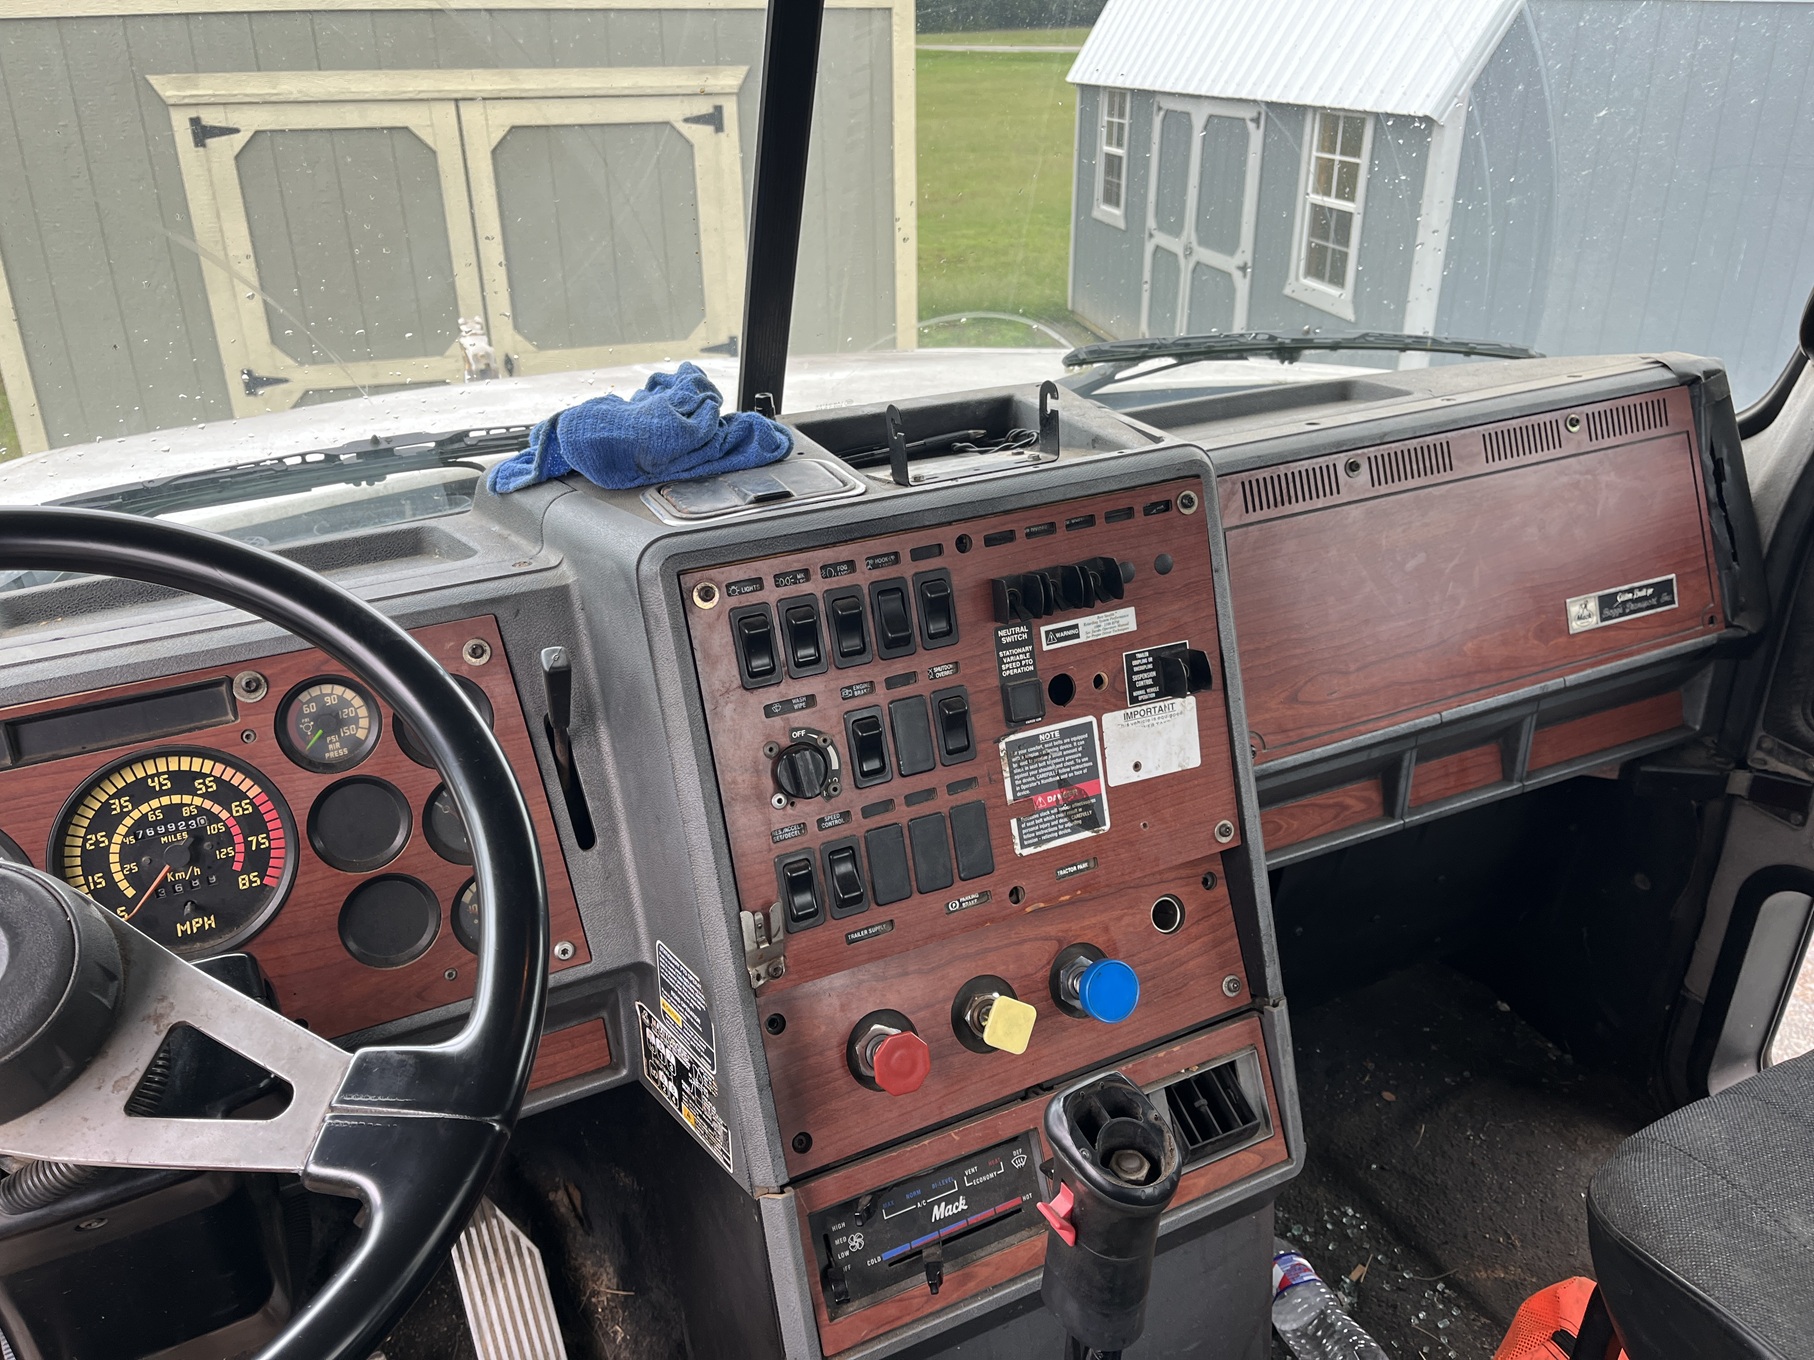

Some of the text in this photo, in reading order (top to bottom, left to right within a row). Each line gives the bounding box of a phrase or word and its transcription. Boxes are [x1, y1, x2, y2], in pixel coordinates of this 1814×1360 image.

[741, 584, 760, 592] LIGHTS
[998, 626, 1028, 636] NEUTRAL
[1056, 629, 1079, 638] WARNING
[1002, 633, 1028, 644] SWITCH
[999, 646, 1032, 657] STATIONARY
[1003, 653, 1030, 663] VARIABLE
[1002, 659, 1033, 670] SPEED PTO
[1002, 666, 1034, 676] OPERATION
[324, 695, 338, 705] 90
[303, 703, 316, 713] 60
[794, 702, 807, 710] WIPE
[1124, 702, 1175, 720] IMPORTANT
[339, 708, 355, 719] 120
[340, 725, 356, 737] 150
[792, 730, 806, 738] OFF
[1039, 731, 1060, 741] NOTE
[327, 735, 338, 743] PSI
[329, 742, 340, 751] AIR
[325, 748, 348, 759] PRESS
[148, 775, 172, 792] 45
[194, 777, 217, 794] 55
[109, 797, 132, 814] 35
[182, 805, 198, 817] 85
[231, 800, 253, 817] 65
[148, 810, 163, 822] 65
[207, 823, 225, 834] 105
[821, 819, 844, 828] CONTROL
[86, 832, 109, 850] 25
[123, 835, 136, 844] 45
[161, 832, 188, 844] MILES
[248, 834, 269, 850] 75
[216, 847, 235, 859] 125
[123, 862, 138, 874] 25
[1077, 862, 1088, 870] PARK
[167, 866, 201, 883] Km/h
[88, 873, 106, 890] 15
[238, 872, 261, 890] 85
[177, 915, 216, 937] MPH
[848, 924, 887, 940] TRAILER SUPPLY
[1013, 1148, 1022, 1156] DEF
[965, 1158, 1000, 1176] VENT HEAT
[973, 1172, 997, 1186] ECONOMY
[882, 1177, 954, 1208] MAX NORM BI-LEVEL
[1022, 1193, 1033, 1201] HOT
[917, 1200, 927, 1208] A/C
[932, 1196, 968, 1222] Mack
[832, 1222, 846, 1231] HIGH
[835, 1236, 846, 1245] MED
[838, 1250, 850, 1260] LOW
[867, 1256, 881, 1266] COLD
